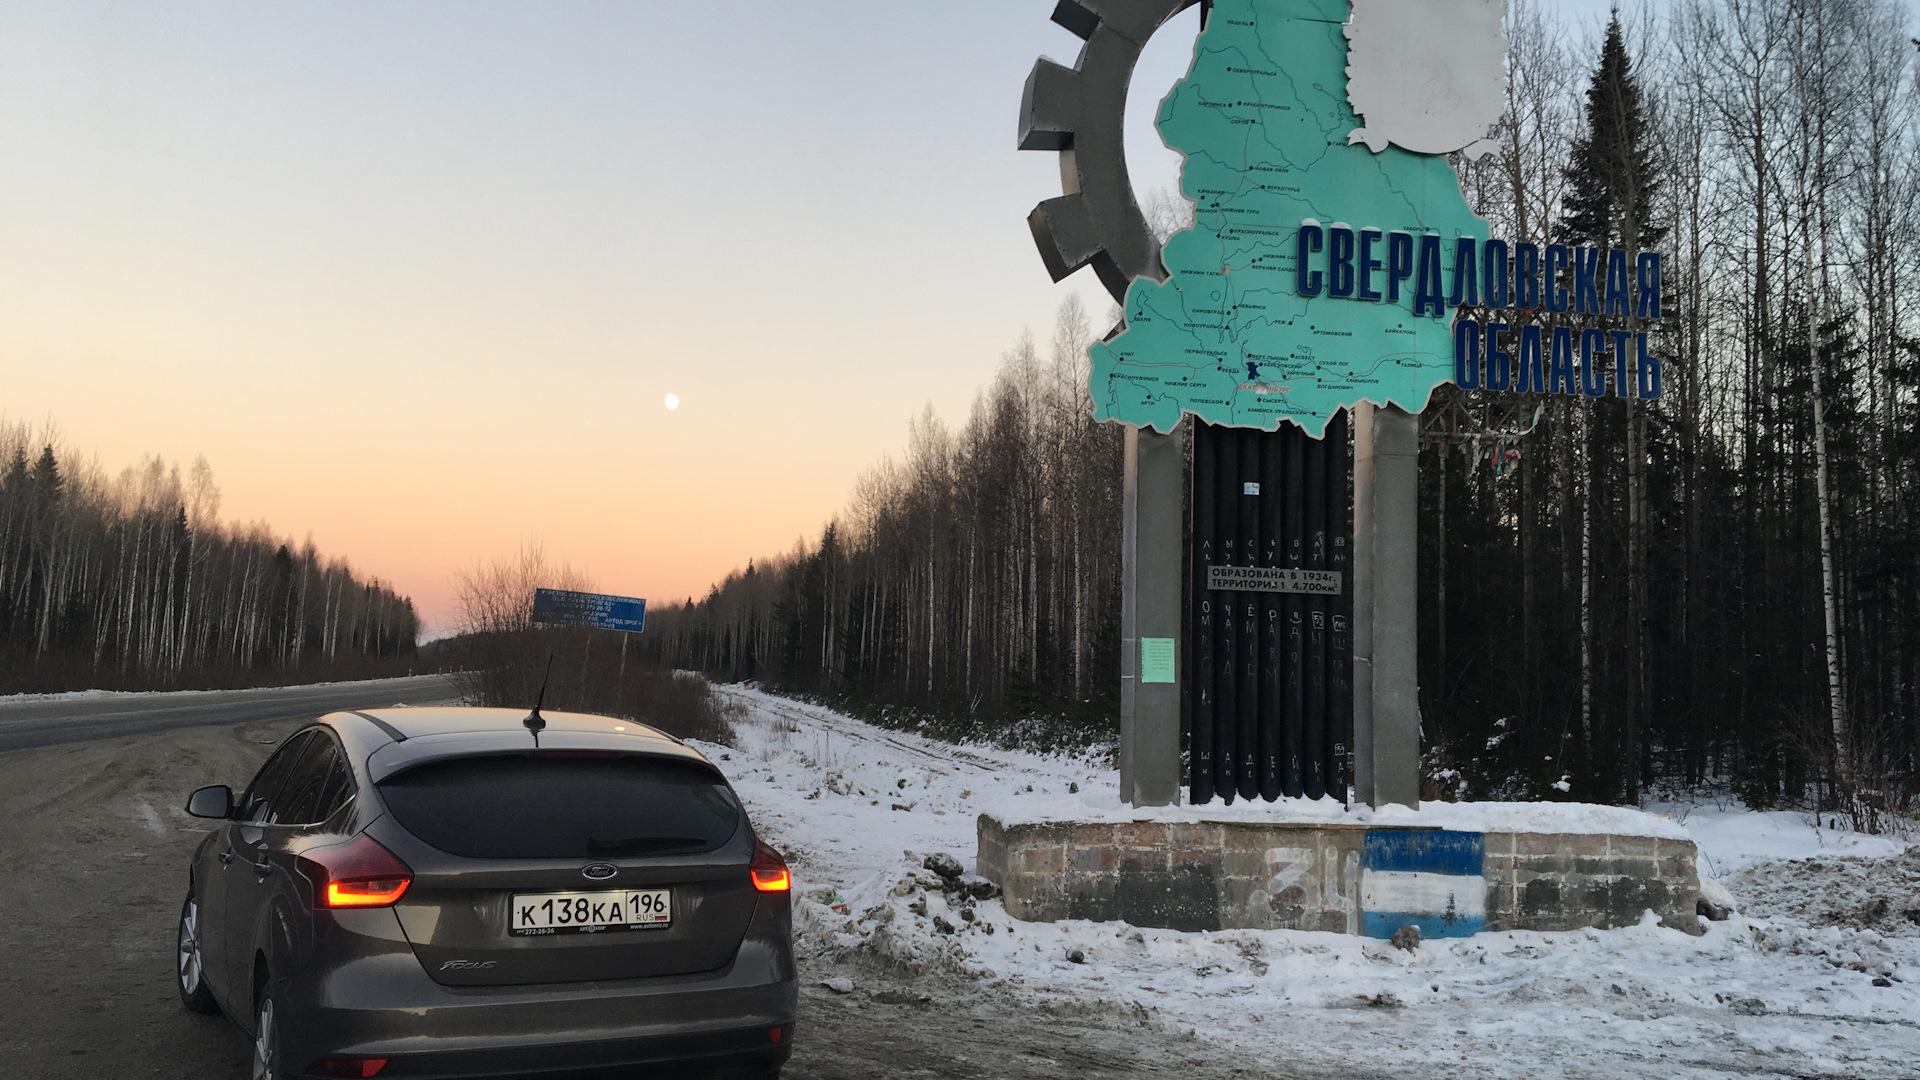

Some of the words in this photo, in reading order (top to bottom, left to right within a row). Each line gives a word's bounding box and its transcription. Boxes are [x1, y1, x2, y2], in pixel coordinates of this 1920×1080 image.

[1297, 222, 1662, 320] СВЕРДЛОВСКАЯ
[1455, 320, 1662, 400] ОБЛАСТЬ
[1212, 567, 1286, 580] ОБРАЗОВАНА
[629, 893, 665, 914] 196
[636, 914, 655, 922] RUS
